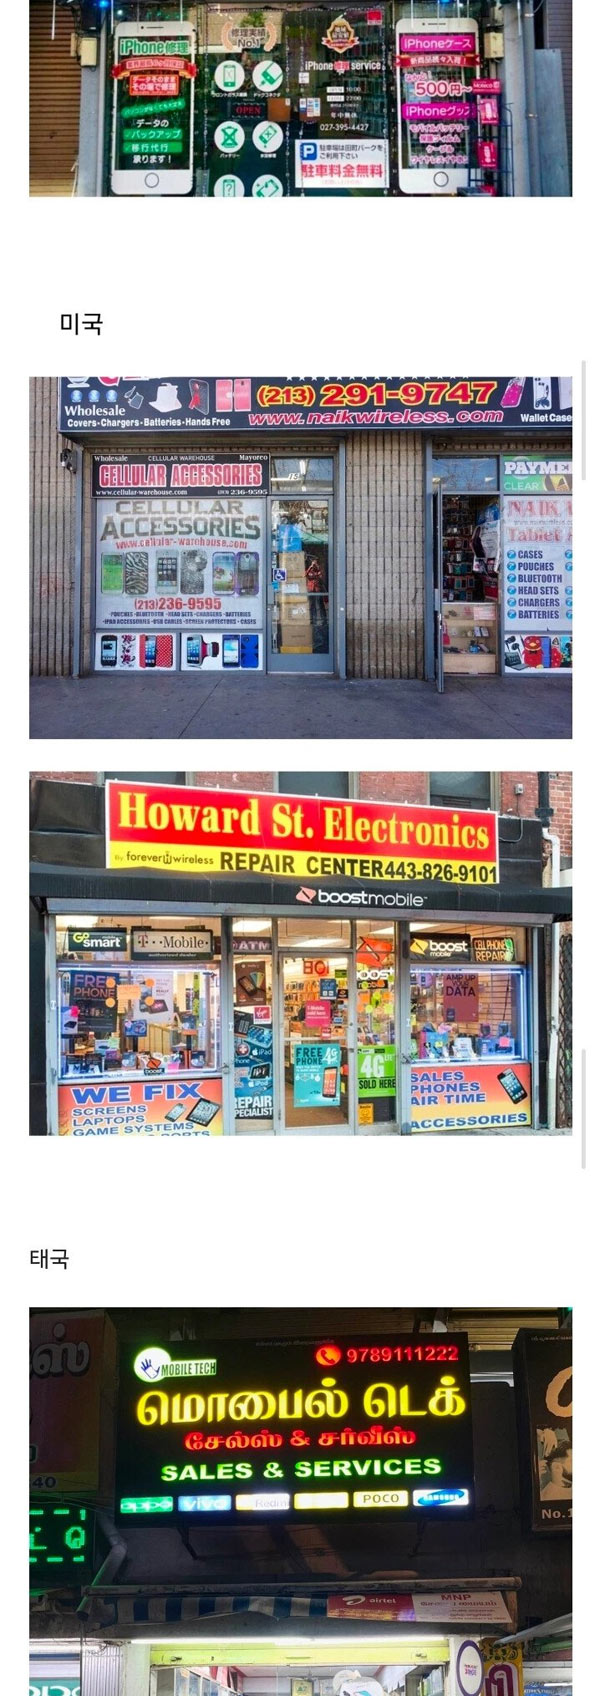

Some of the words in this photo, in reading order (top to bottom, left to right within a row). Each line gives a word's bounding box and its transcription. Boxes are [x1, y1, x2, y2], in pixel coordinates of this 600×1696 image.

[120, 40, 189, 54] iPhone修理
[302, 165, 383, 177] 駐車料金無料
[257, 385, 315, 407] (213)
[320, 382, 498, 406] 291-9747
[65, 405, 125, 416] Wholesale
[248, 409, 503, 425] www.naikwireless.com
[100, 464, 166, 487] CELLULAR
[171, 463, 262, 486] ACCESSORIES
[100, 516, 260, 541] ACCESSORIES
[518, 575, 562, 583] BLUETOOTH
[118, 792, 260, 835] Howard
[272, 803, 314, 839] St.
[324, 806, 489, 849] Electronics
[221, 852, 295, 873] REPAIR
[307, 856, 383, 877] CENTER
[384, 862, 497, 883] 443-826-9101
[359, 1080, 376, 1089] SOLD
[379, 1079, 396, 1088] HERE
[71, 1086, 130, 1104] WE
[144, 1083, 203, 1100] FIX
[444, 1093, 485, 1103] TIME
[73, 1106, 146, 1116] SCREENS
[73, 1116, 144, 1126] LAPTOPS
[129, 1122, 193, 1133] SYSTEMS
[411, 1113, 527, 1128] ACCESSORIES
[347, 1347, 458, 1363] 9789111222
[161, 1363, 192, 1376] MOBILE
[195, 1362, 216, 1375] TECH
[137, 1378, 349, 1426] மொபைல்
[364, 1376, 466, 1419] டெக்
[161, 1463, 253, 1481] SALES
[295, 1458, 441, 1477] SERVICES
[364, 1494, 399, 1503] POCO
